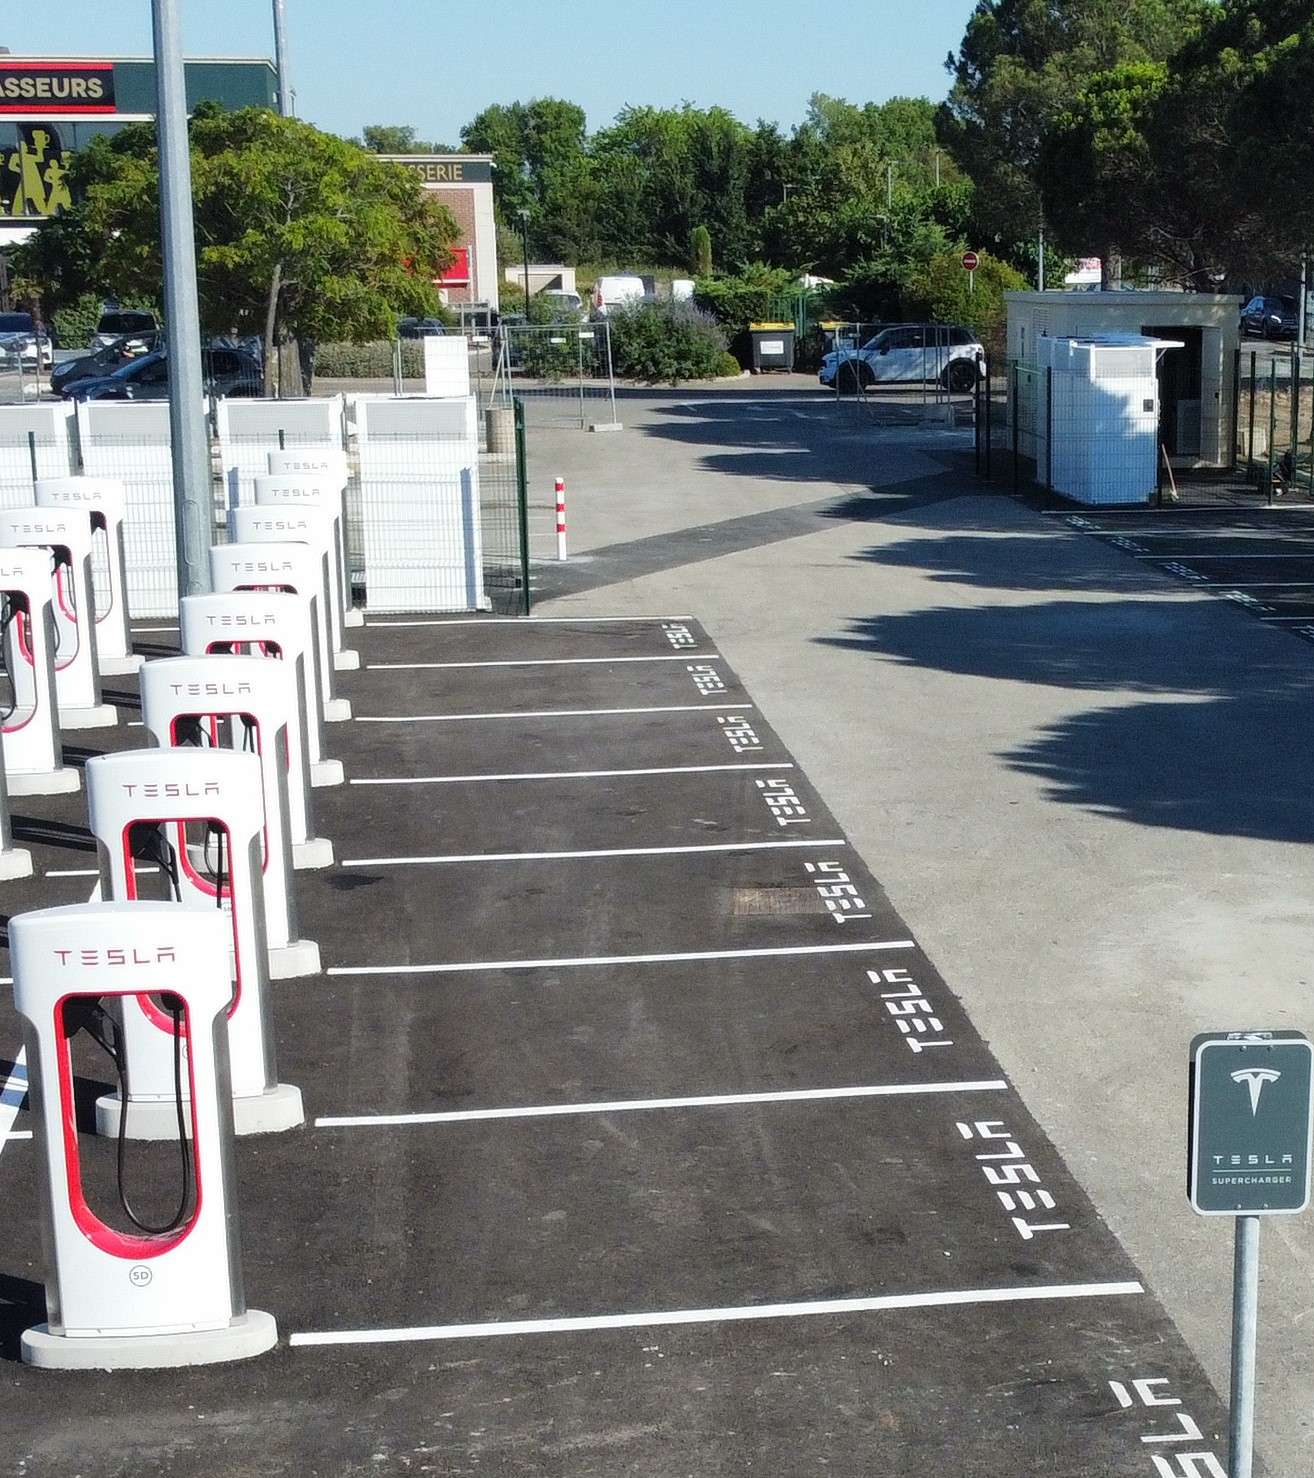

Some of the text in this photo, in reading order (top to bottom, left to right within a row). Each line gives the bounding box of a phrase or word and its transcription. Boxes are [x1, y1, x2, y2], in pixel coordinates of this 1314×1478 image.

[283, 462, 328, 470] TESLA
[51, 492, 102, 501] TESLA
[271, 488, 321, 497] TESLA
[10, 523, 66, 533] TESLA
[252, 521, 307, 530] TESLA
[231, 562, 293, 572] TESLA
[206, 615, 276, 626] TESLA
[170, 683, 251, 696] TESLA
[717, 715, 764, 753] TESLA
[122, 781, 220, 798] TESLA
[755, 778, 811, 827] TESLA
[804, 860, 872, 924] TESLA
[54, 945, 176, 967] TESLA
[867, 968, 954, 1053] TESLA
[1212, 1154, 1293, 1165] TESLA
[956, 1121, 1070, 1240] TESLA
[1212, 1175, 1293, 1185] SUPERCHARGER
[1108, 1377, 1229, 1478] SLA
